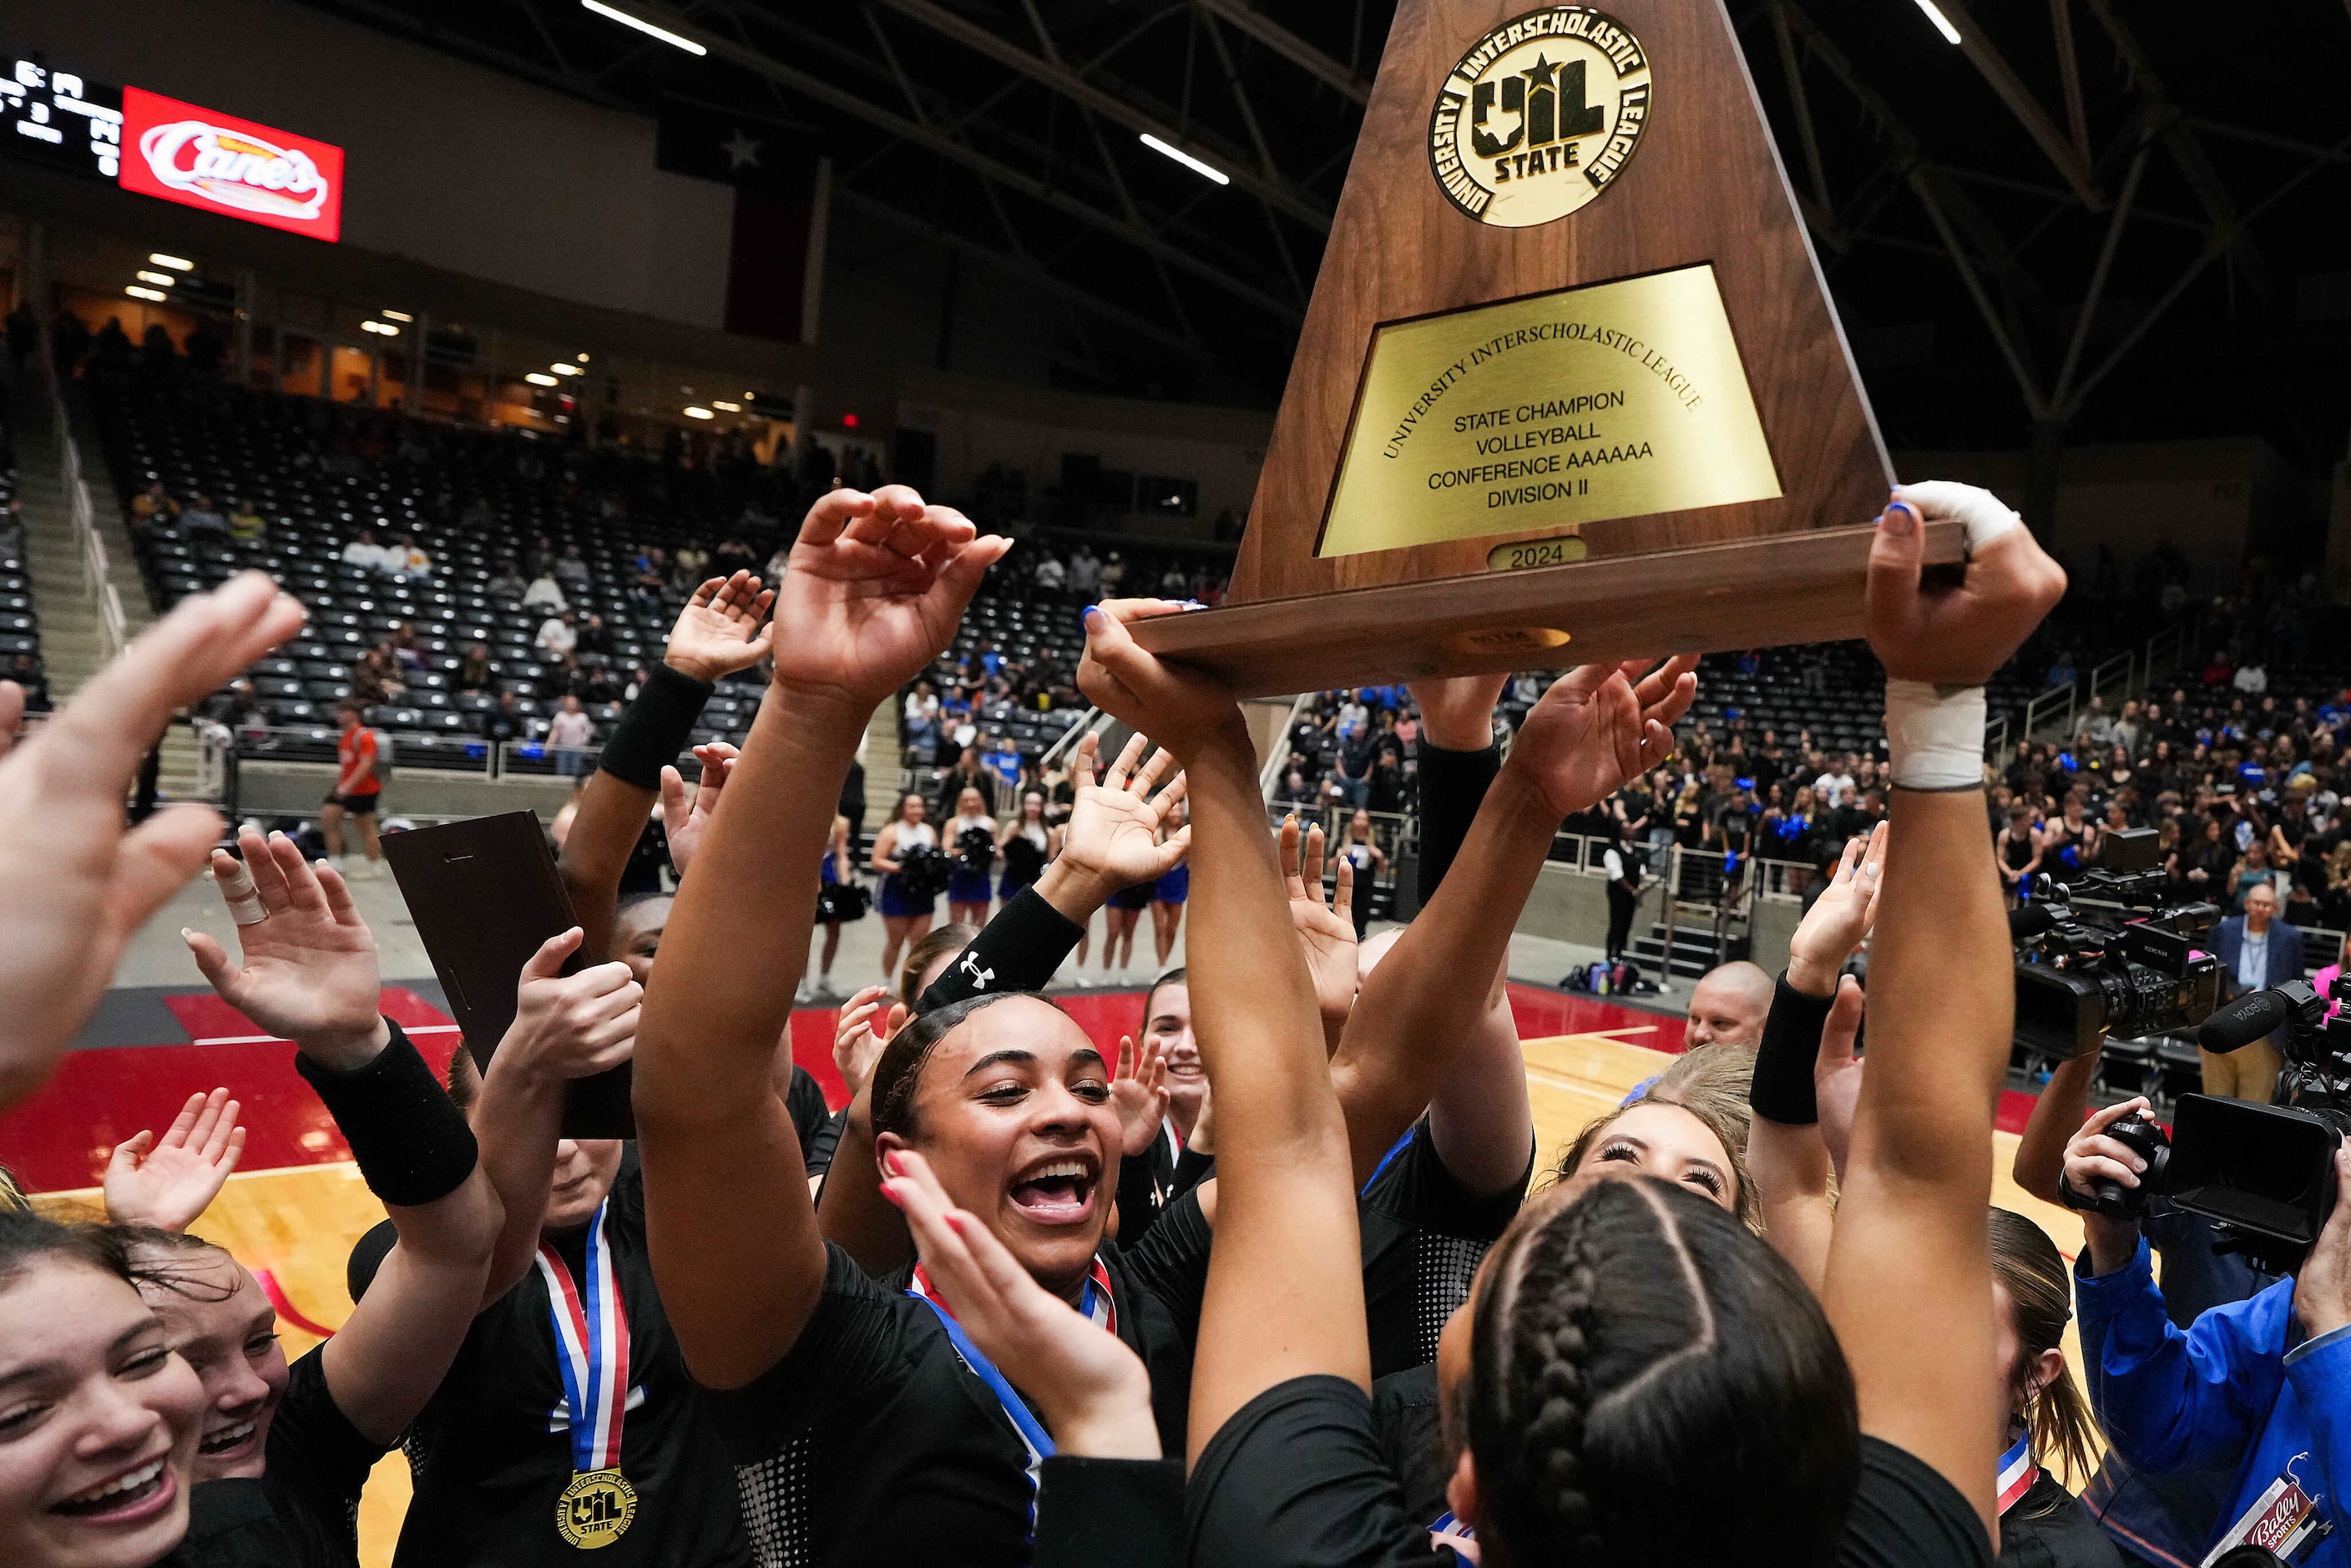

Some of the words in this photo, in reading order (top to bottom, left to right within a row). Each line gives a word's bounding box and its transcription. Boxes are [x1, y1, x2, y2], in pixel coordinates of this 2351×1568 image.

[1460, 13, 1641, 80] INTERSCHOLASTIC
[153, 120, 319, 194] Cane's
[1433, 96, 1490, 214] UNIVERSITY
[1588, 89, 1646, 184] LEAGUE
[1494, 142, 1580, 184] STATE
[1383, 359, 1467, 459] UNIVERSITY
[1470, 322, 1644, 366] INTERSCHOLASTIC
[1641, 349, 1703, 412] LEAGUE
[1454, 409, 1510, 432] STATE
[1516, 390, 1625, 422] CHAMPION
[1477, 422, 1601, 456] VOLLEYBALL
[1428, 455, 1560, 489] CONFERENCE
[1566, 442, 1653, 469] AAAAAA
[1488, 481, 1572, 508] DIVISION
[1579, 478, 1589, 495] II
[1510, 544, 1564, 569] 2024
[2232, 1003, 2261, 1021] BOYA
[567, 1474, 636, 1498] INTERSCHOLASTIC
[580, 1520, 614, 1535] STATE
[2251, 1492, 2300, 1546] Bally
[2268, 1515, 2297, 1549] SPORTS
